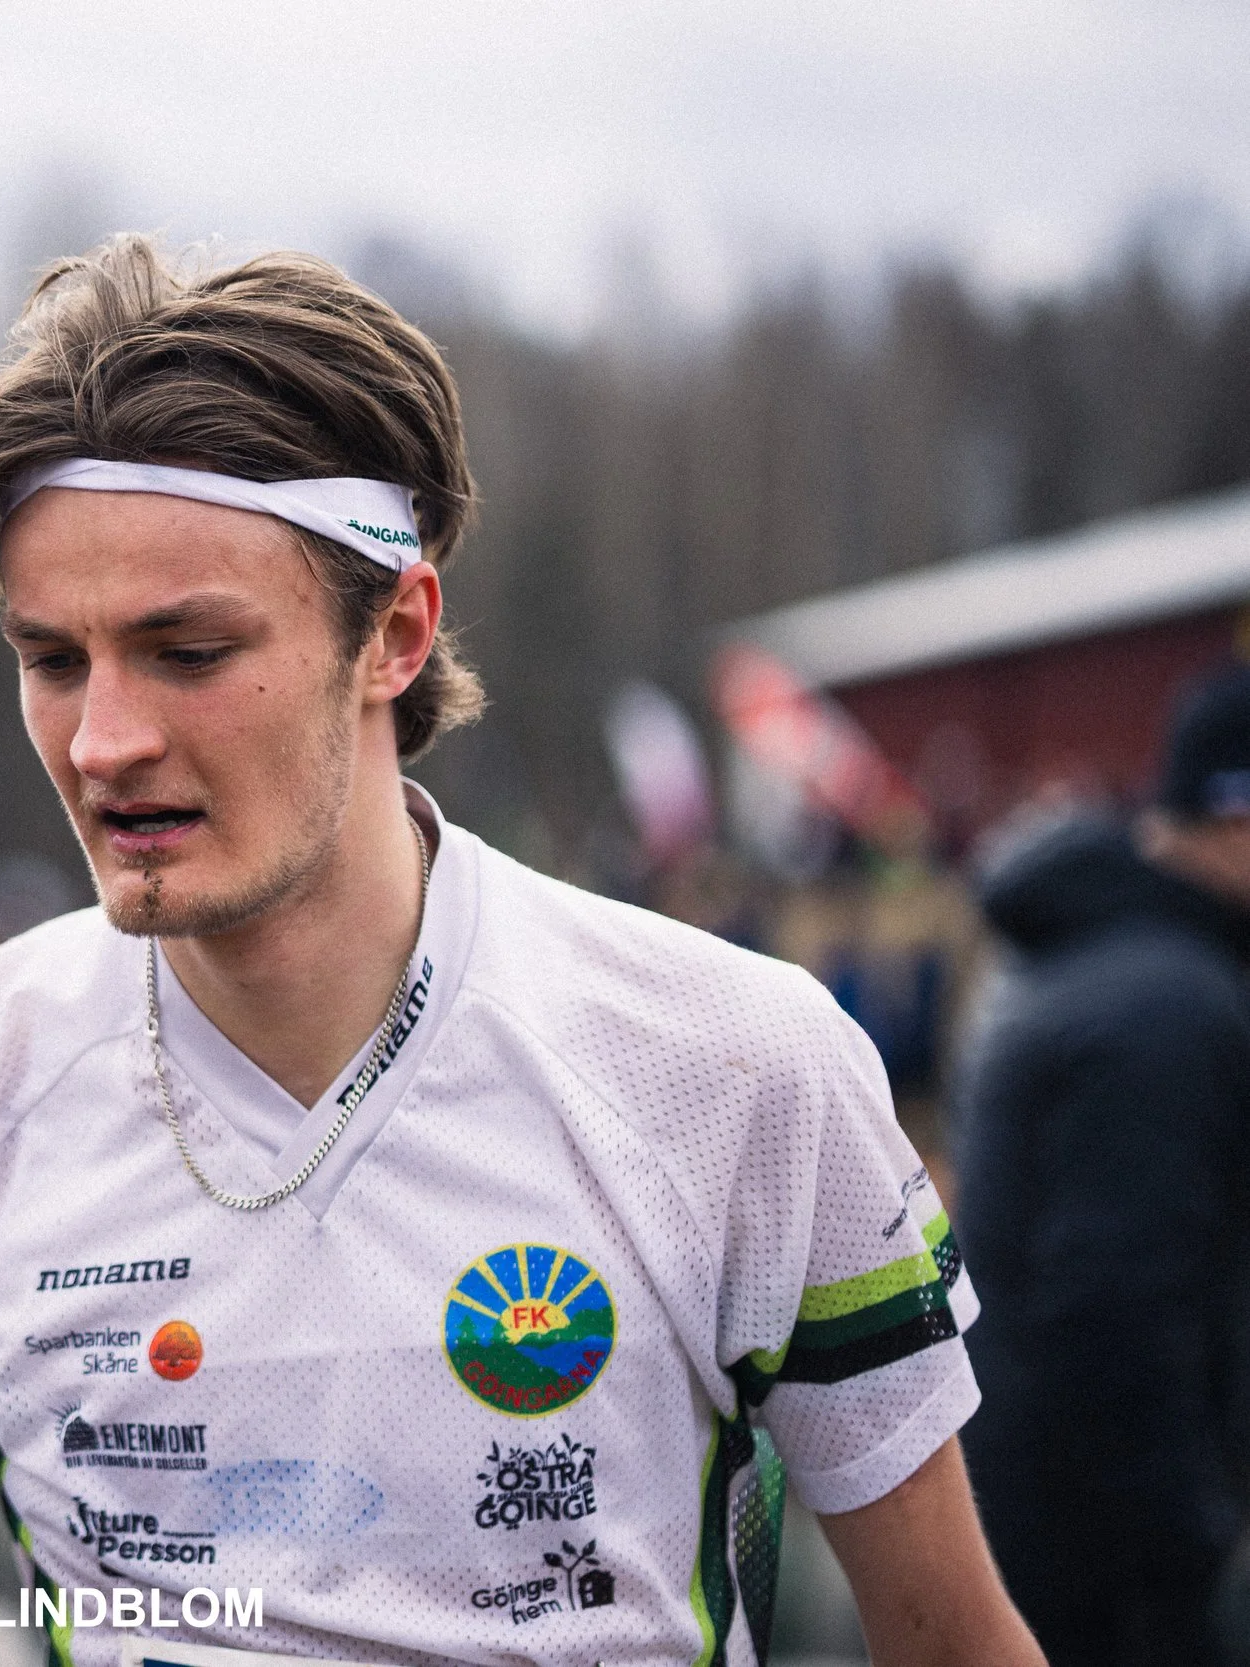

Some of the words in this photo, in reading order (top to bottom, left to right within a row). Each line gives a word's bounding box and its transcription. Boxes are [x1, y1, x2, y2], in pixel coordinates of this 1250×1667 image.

[36, 1257, 191, 1292] noname
[513, 1304, 551, 1330] FK
[25, 1327, 141, 1354] Sparbanken
[83, 1352, 138, 1375] Skåne
[100, 1422, 208, 1453] ENERMONT
[497, 1459, 594, 1491] ÖSTRA
[475, 1487, 597, 1530] GÖINGE
[98, 1535, 215, 1564] Persson
[471, 1573, 558, 1609] Göinge
[513, 1598, 562, 1625] hem
